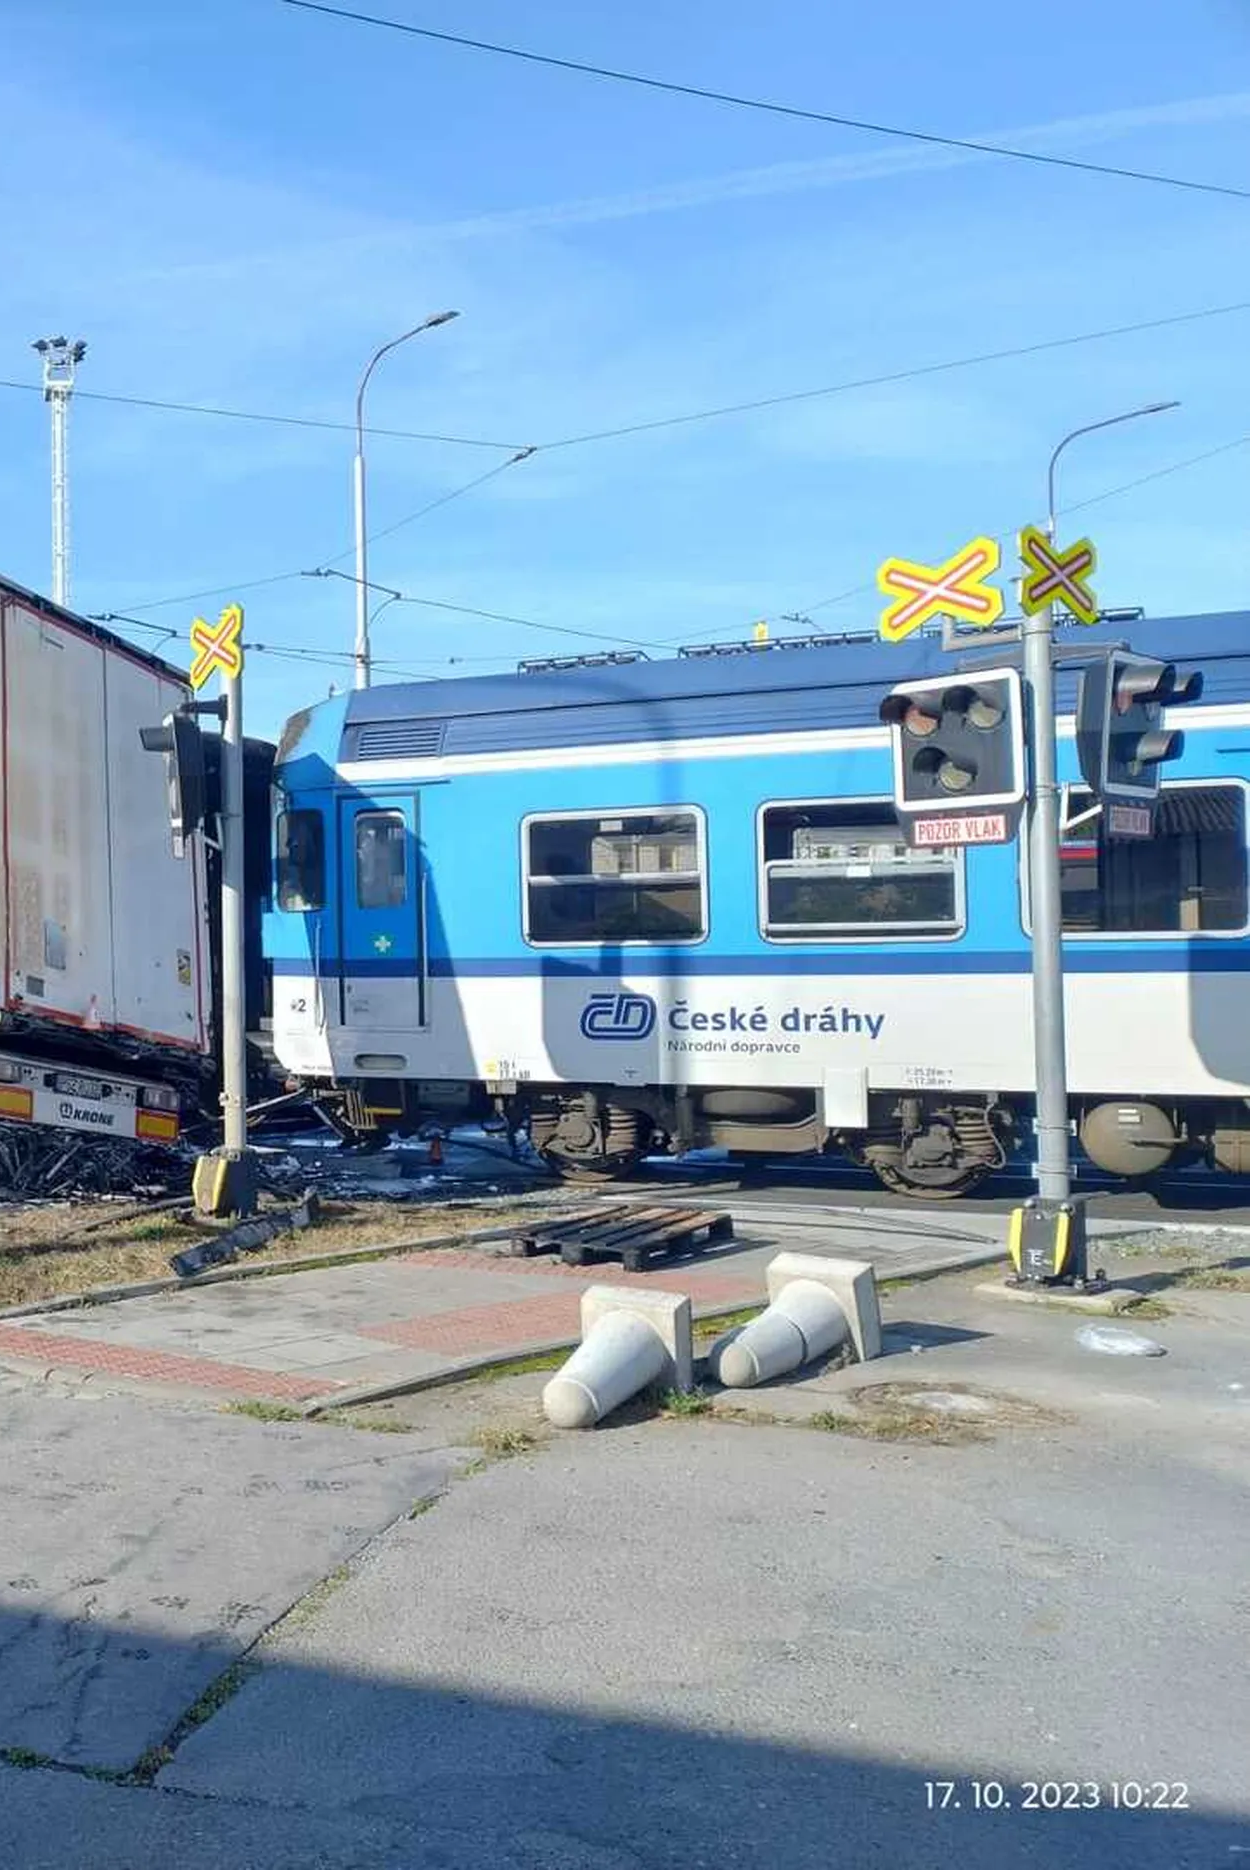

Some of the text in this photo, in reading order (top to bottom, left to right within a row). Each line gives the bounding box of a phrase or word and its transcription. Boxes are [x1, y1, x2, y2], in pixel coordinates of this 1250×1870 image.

[918, 818, 1002, 841] POZOR VLAK
[668, 1000, 885, 1039] České dráhy
[667, 1039, 801, 1054] Národní dopravce
[73, 1108, 115, 1126] KRONE
